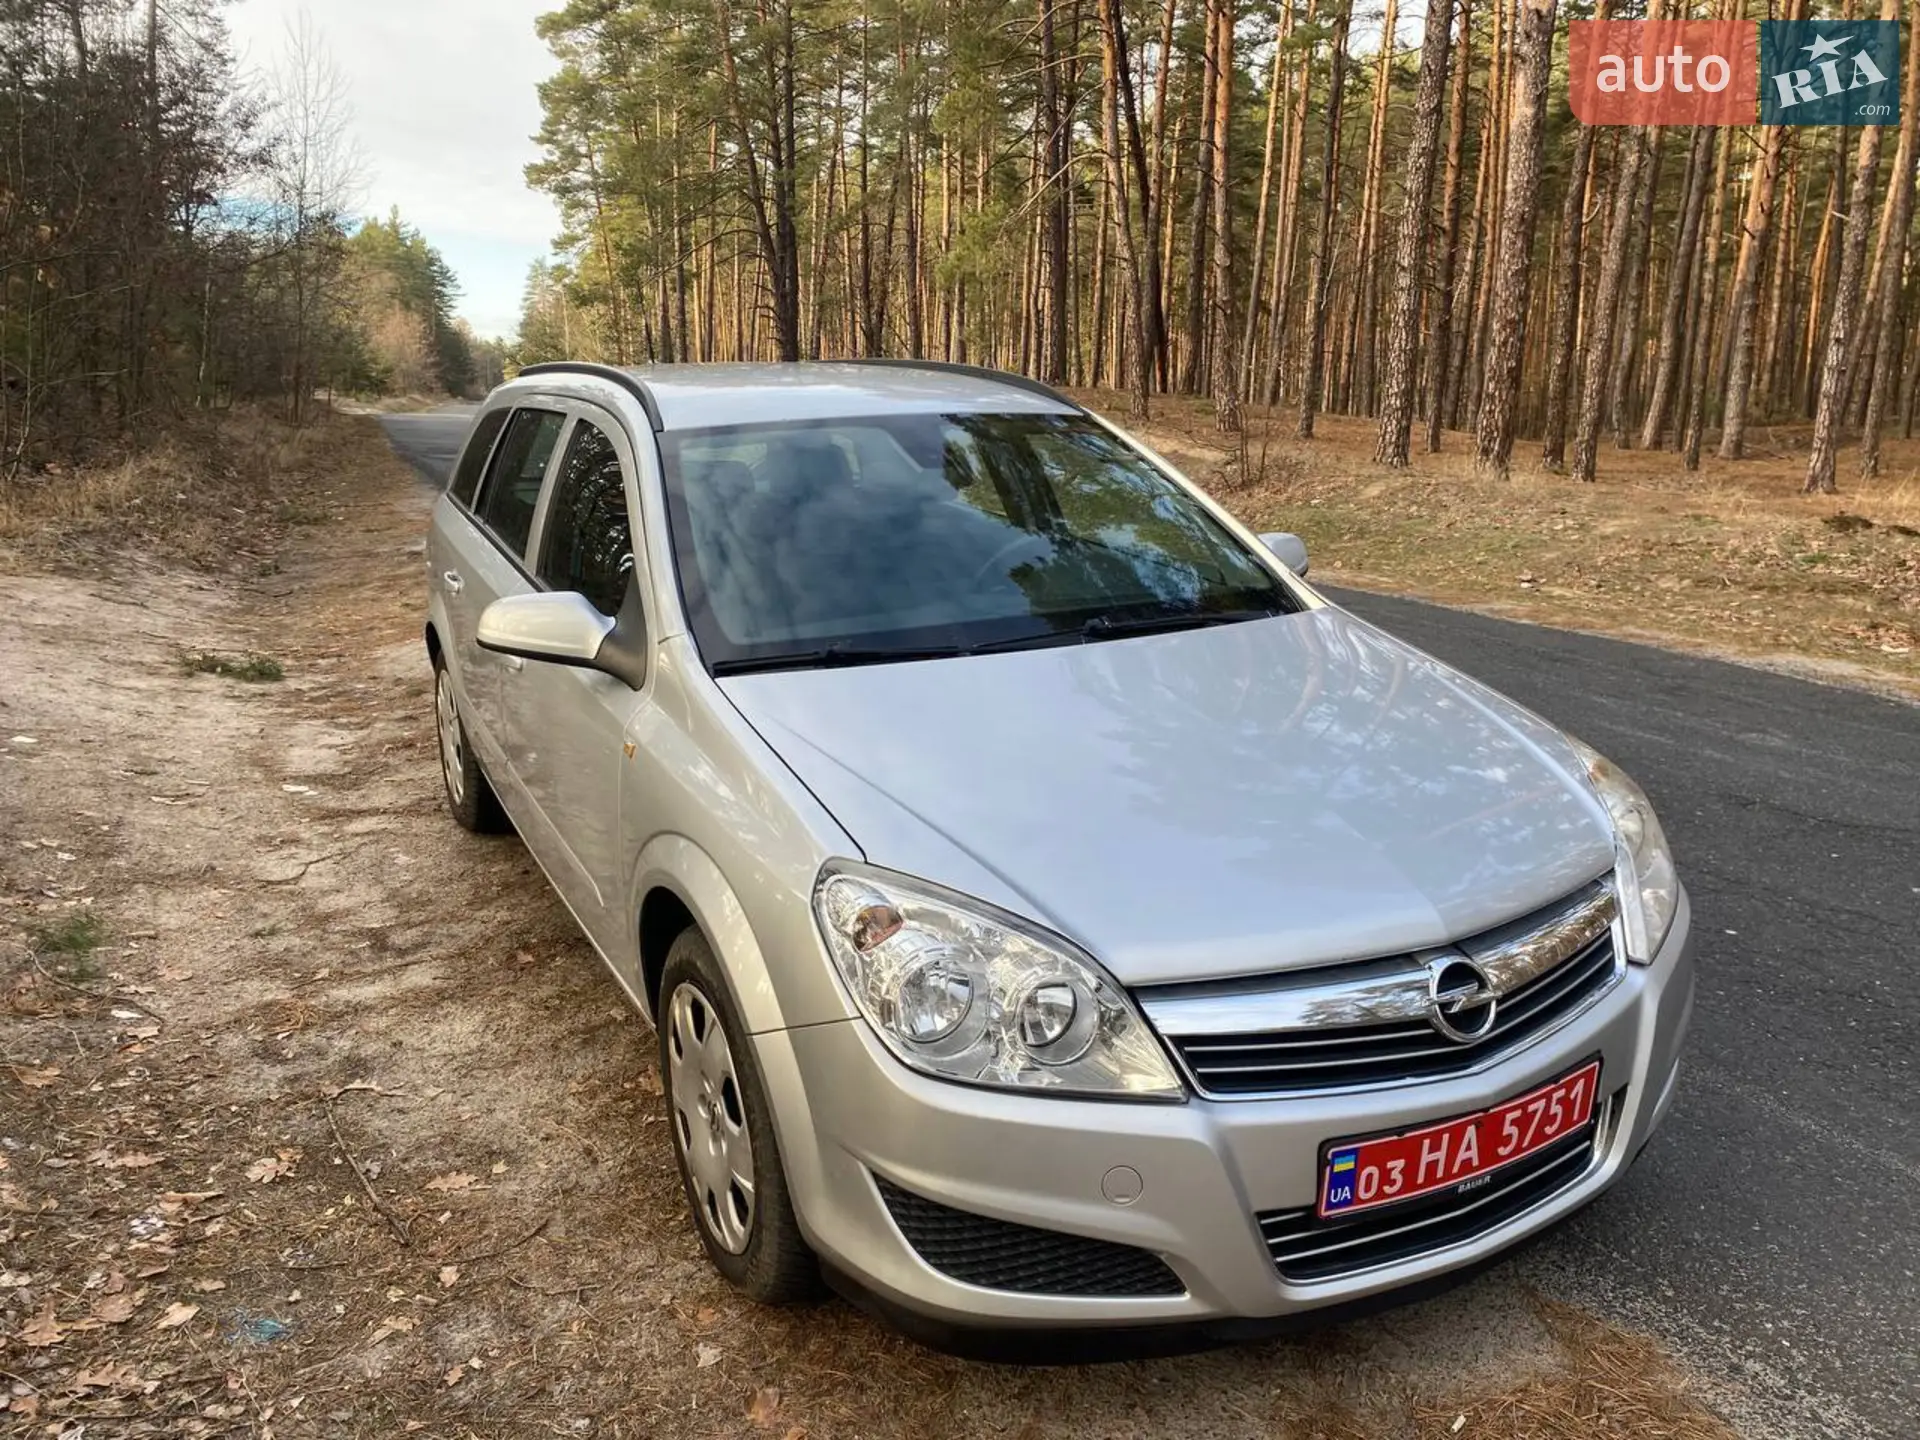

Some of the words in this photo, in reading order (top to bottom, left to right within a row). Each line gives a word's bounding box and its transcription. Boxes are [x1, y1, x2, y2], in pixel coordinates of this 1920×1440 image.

[1358, 1158, 1406, 1200] 03
[1417, 1124, 1480, 1185] HA
[1497, 1078, 1586, 1156] 5751
[1330, 1185, 1352, 1203] UA
